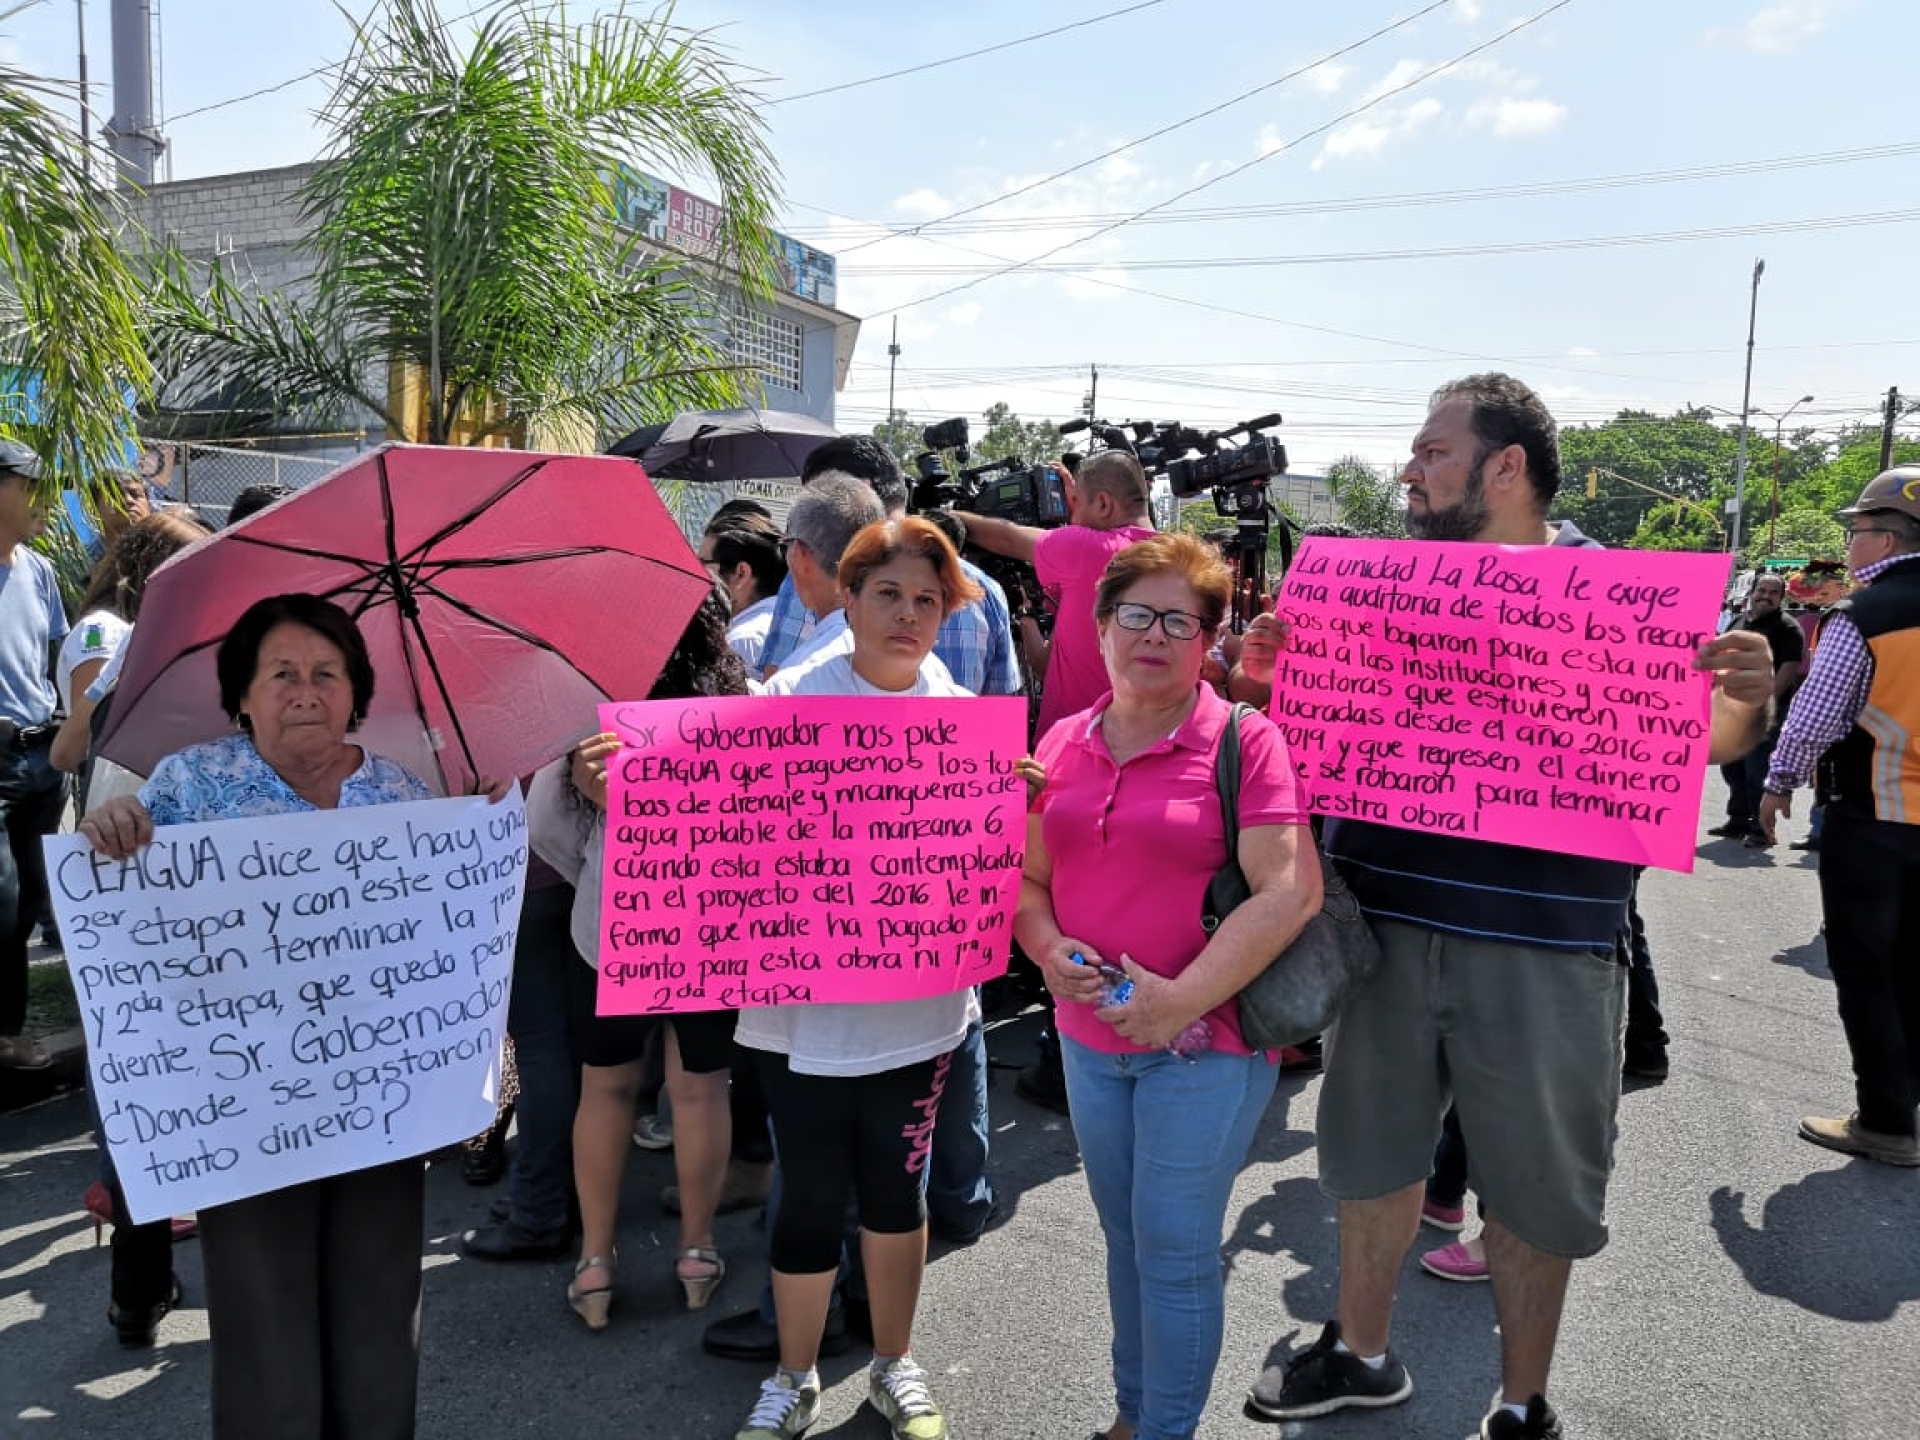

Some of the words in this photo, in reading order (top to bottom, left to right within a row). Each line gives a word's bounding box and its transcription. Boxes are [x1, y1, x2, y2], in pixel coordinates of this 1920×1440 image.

[1297, 546, 1327, 576] La
[1336, 555, 1416, 584] unidad
[1428, 555, 1460, 590] La
[1565, 566, 1592, 601] le
[1282, 606, 1324, 632] sos
[1330, 617, 1375, 643] que
[1384, 620, 1478, 658] bajaron
[1490, 637, 1549, 669] para
[1562, 648, 1635, 677] esta
[1287, 580, 1328, 604] una
[1450, 593, 1485, 621] de
[1499, 600, 1575, 634] todos
[1585, 616, 1626, 645] los
[1281, 662, 1393, 696] tructoras
[1405, 684, 1453, 712] que
[1468, 687, 1618, 731] estuvieron
[1336, 645, 1351, 666] a
[1360, 642, 1394, 672] las
[1403, 653, 1566, 698] instituciones
[1577, 681, 1591, 710] y
[678, 708, 830, 755] Gobernador
[844, 722, 894, 749] nos
[905, 718, 958, 762] pide
[1280, 689, 1384, 727] lucradas
[1395, 707, 1473, 734] desde
[1482, 714, 1505, 741] el
[1516, 724, 1575, 756] año
[1580, 733, 1652, 764] 2016
[1662, 745, 1691, 769] al
[622, 757, 722, 787] CEAGUA
[730, 761, 773, 792] que
[784, 753, 924, 790] paguemos
[939, 752, 979, 775] los
[1320, 758, 1347, 784] se
[1356, 761, 1456, 795] robaron
[1476, 783, 1539, 810] para
[1551, 784, 1671, 827] terminar
[1338, 739, 1351, 765] y
[1358, 738, 1404, 768] que
[1418, 744, 1521, 783] regresen
[1538, 750, 1564, 780] el
[1576, 764, 1681, 795] dinero
[678, 792, 711, 815] de
[719, 789, 806, 819] drenaje
[807, 789, 829, 817] y
[837, 778, 984, 816] mangueras
[987, 776, 1019, 794] de
[58, 837, 226, 902] CEAGUA
[238, 840, 320, 882] dice
[335, 834, 398, 880] que
[410, 821, 481, 865] hay
[490, 808, 527, 845] una
[616, 824, 679, 856] agua
[690, 820, 777, 853] potable
[787, 819, 818, 840] de
[832, 814, 854, 840] la
[869, 819, 973, 840] manzana
[985, 804, 1004, 837] 6
[614, 856, 701, 881] cuando
[711, 854, 762, 879] esta
[774, 849, 851, 877] estaba
[871, 845, 1025, 881] contemplada
[71, 908, 126, 951] 3er
[129, 908, 246, 955] etapa
[262, 901, 282, 935] y
[294, 887, 351, 918] con
[361, 866, 433, 904] este
[614, 888, 651, 911] en
[663, 885, 687, 909] el
[697, 880, 799, 918] proyecto
[813, 882, 855, 906] del
[948, 880, 969, 907] le
[80, 947, 248, 1000] piensan
[264, 917, 423, 965] terminar
[445, 899, 475, 934] la
[698, 922, 740, 952] que
[750, 912, 811, 940] nadie
[828, 912, 861, 939] ha
[879, 912, 967, 948] pagado
[978, 912, 1005, 933] un
[604, 956, 686, 988] quinto
[699, 956, 748, 988] para
[760, 946, 822, 972] esta
[837, 946, 902, 971] obra
[915, 948, 941, 969] ni
[972, 947, 993, 972] y
[721, 980, 812, 1009] etapa
[91, 1006, 109, 1048] y
[178, 987, 284, 1027] etapa,
[301, 973, 356, 1017] que
[372, 953, 457, 1000] quedo
[210, 1033, 272, 1081] Sr.
[271, 1076, 316, 1108] se
[334, 1027, 493, 1106] gastaron
[145, 1146, 239, 1187] tanto
[259, 1080, 411, 1156] dinero?
